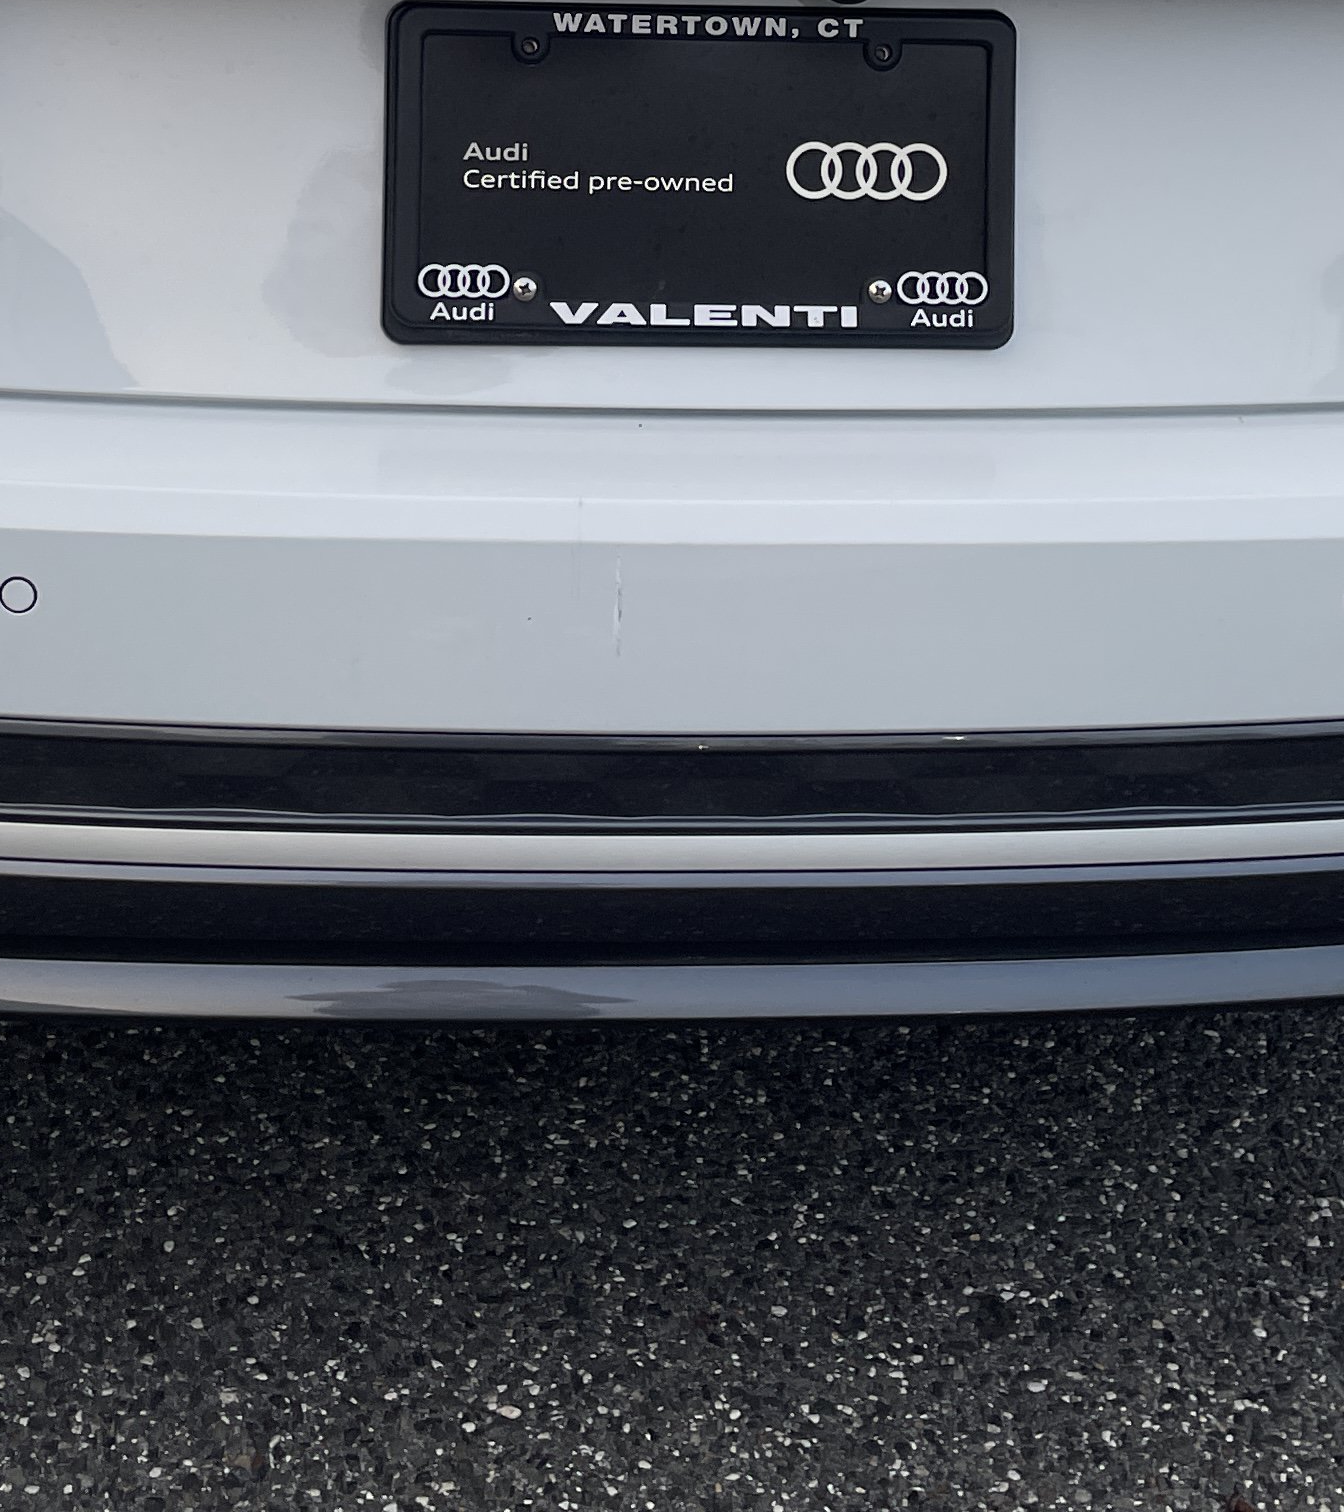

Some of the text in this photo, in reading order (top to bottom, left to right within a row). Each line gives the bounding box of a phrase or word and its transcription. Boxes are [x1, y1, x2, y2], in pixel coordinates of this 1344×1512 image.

[553, 13, 864, 39] WATERTOWN, CT
[463, 142, 528, 161] Audi
[463, 169, 733, 194] Certified pre-owned
[430, 302, 494, 321] Audi
[549, 302, 858, 328] VALENTI
[910, 308, 974, 328] Audi
